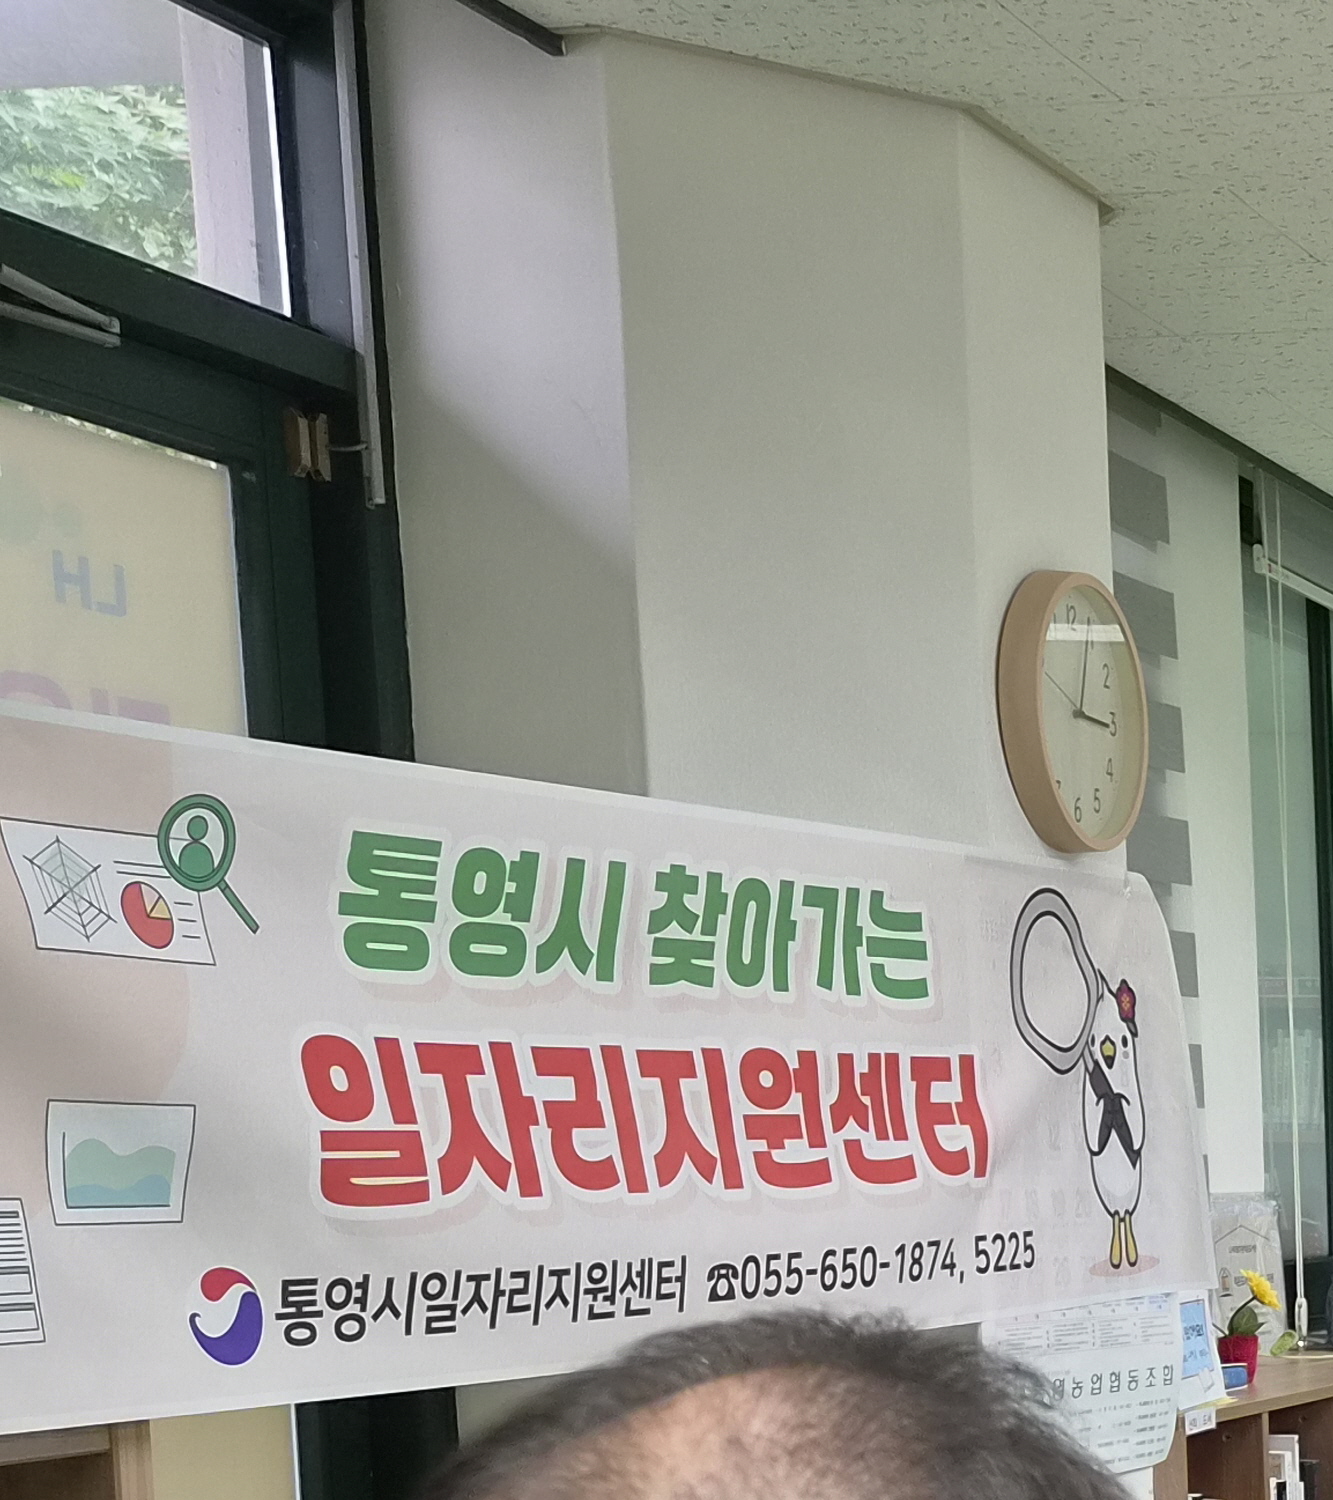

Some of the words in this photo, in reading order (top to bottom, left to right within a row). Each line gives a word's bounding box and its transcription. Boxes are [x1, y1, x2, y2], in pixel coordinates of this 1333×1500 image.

[1102, 663, 1111, 689] 2
[1108, 712, 1118, 737] 3
[1106, 758, 1114, 783] 4
[1074, 797, 1082, 823] 6
[1093, 788, 1101, 814] 5
[338, 828, 628, 983] 통영시
[648, 863, 931, 1000] 찾아가는
[300, 1033, 989, 1207] 일자리지원센터
[275, 1255, 688, 1348] 통영시일자리지원센터
[973, 1230, 1037, 1278] 5225
[1052, 1364, 1174, 1400] 영농업협동조합
